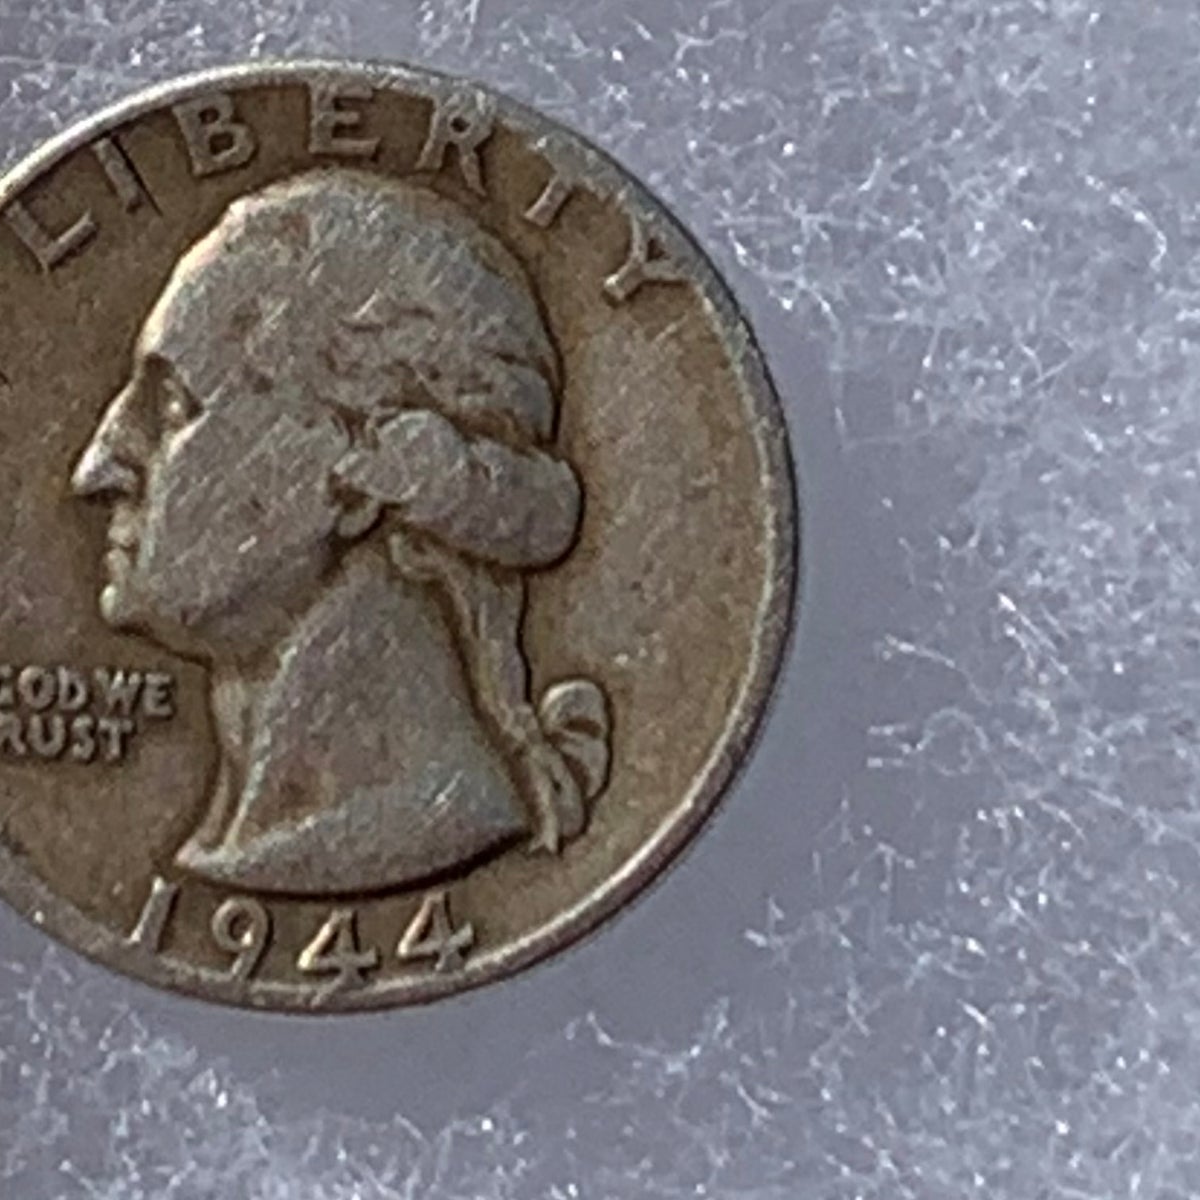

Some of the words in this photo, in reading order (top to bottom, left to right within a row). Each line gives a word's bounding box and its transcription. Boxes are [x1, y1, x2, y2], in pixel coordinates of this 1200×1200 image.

[5, 77, 693, 301] LIBERTY
[95, 668, 173, 717] WE
[124, 875, 475, 996] 1944
